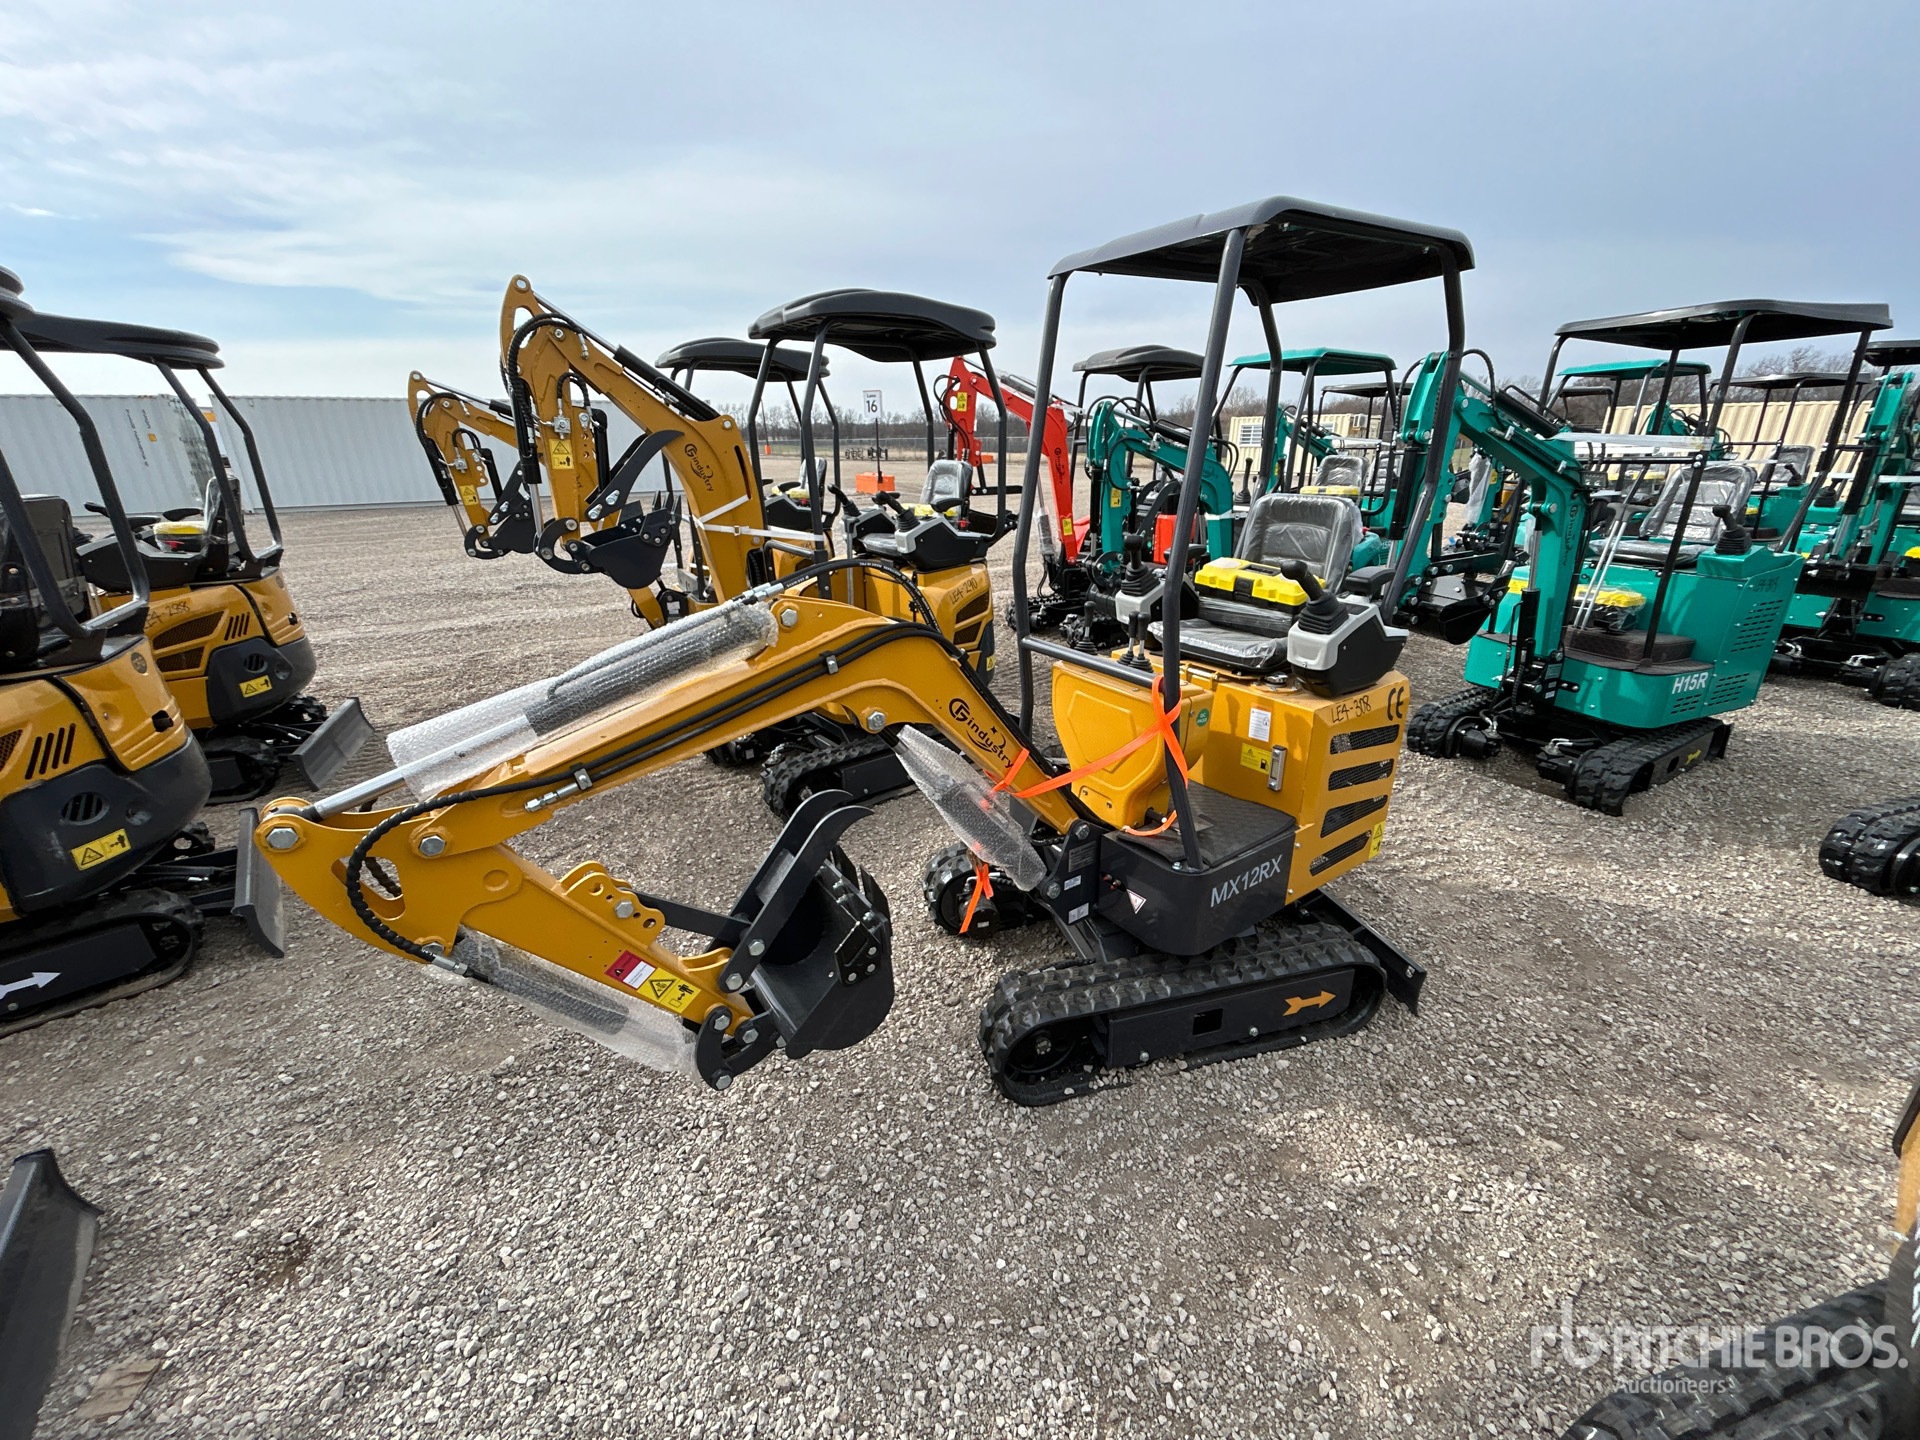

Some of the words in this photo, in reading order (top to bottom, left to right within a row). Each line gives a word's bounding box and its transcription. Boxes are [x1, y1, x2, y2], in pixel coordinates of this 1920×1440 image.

[866, 400, 878, 413] 16
[1672, 672, 1709, 694] H15R
[1331, 695, 1371, 723] LE4-308
[1210, 854, 1283, 908] MX12RX
